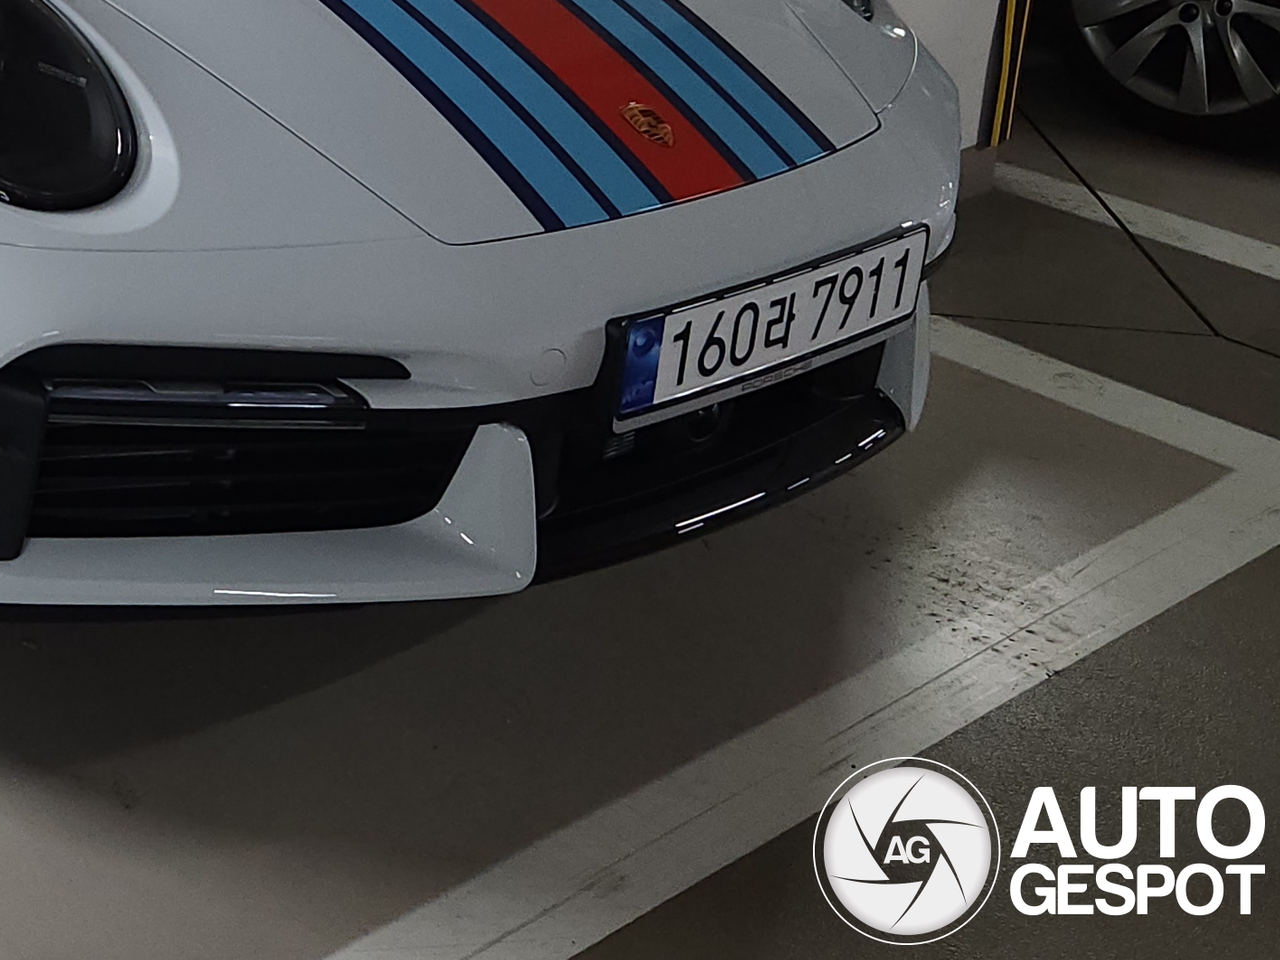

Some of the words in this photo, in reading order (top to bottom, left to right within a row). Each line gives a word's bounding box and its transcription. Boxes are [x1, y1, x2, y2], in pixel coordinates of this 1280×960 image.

[673, 292, 796, 386] 160라
[812, 248, 911, 340] 7911
[741, 360, 813, 392] PORSCHE
